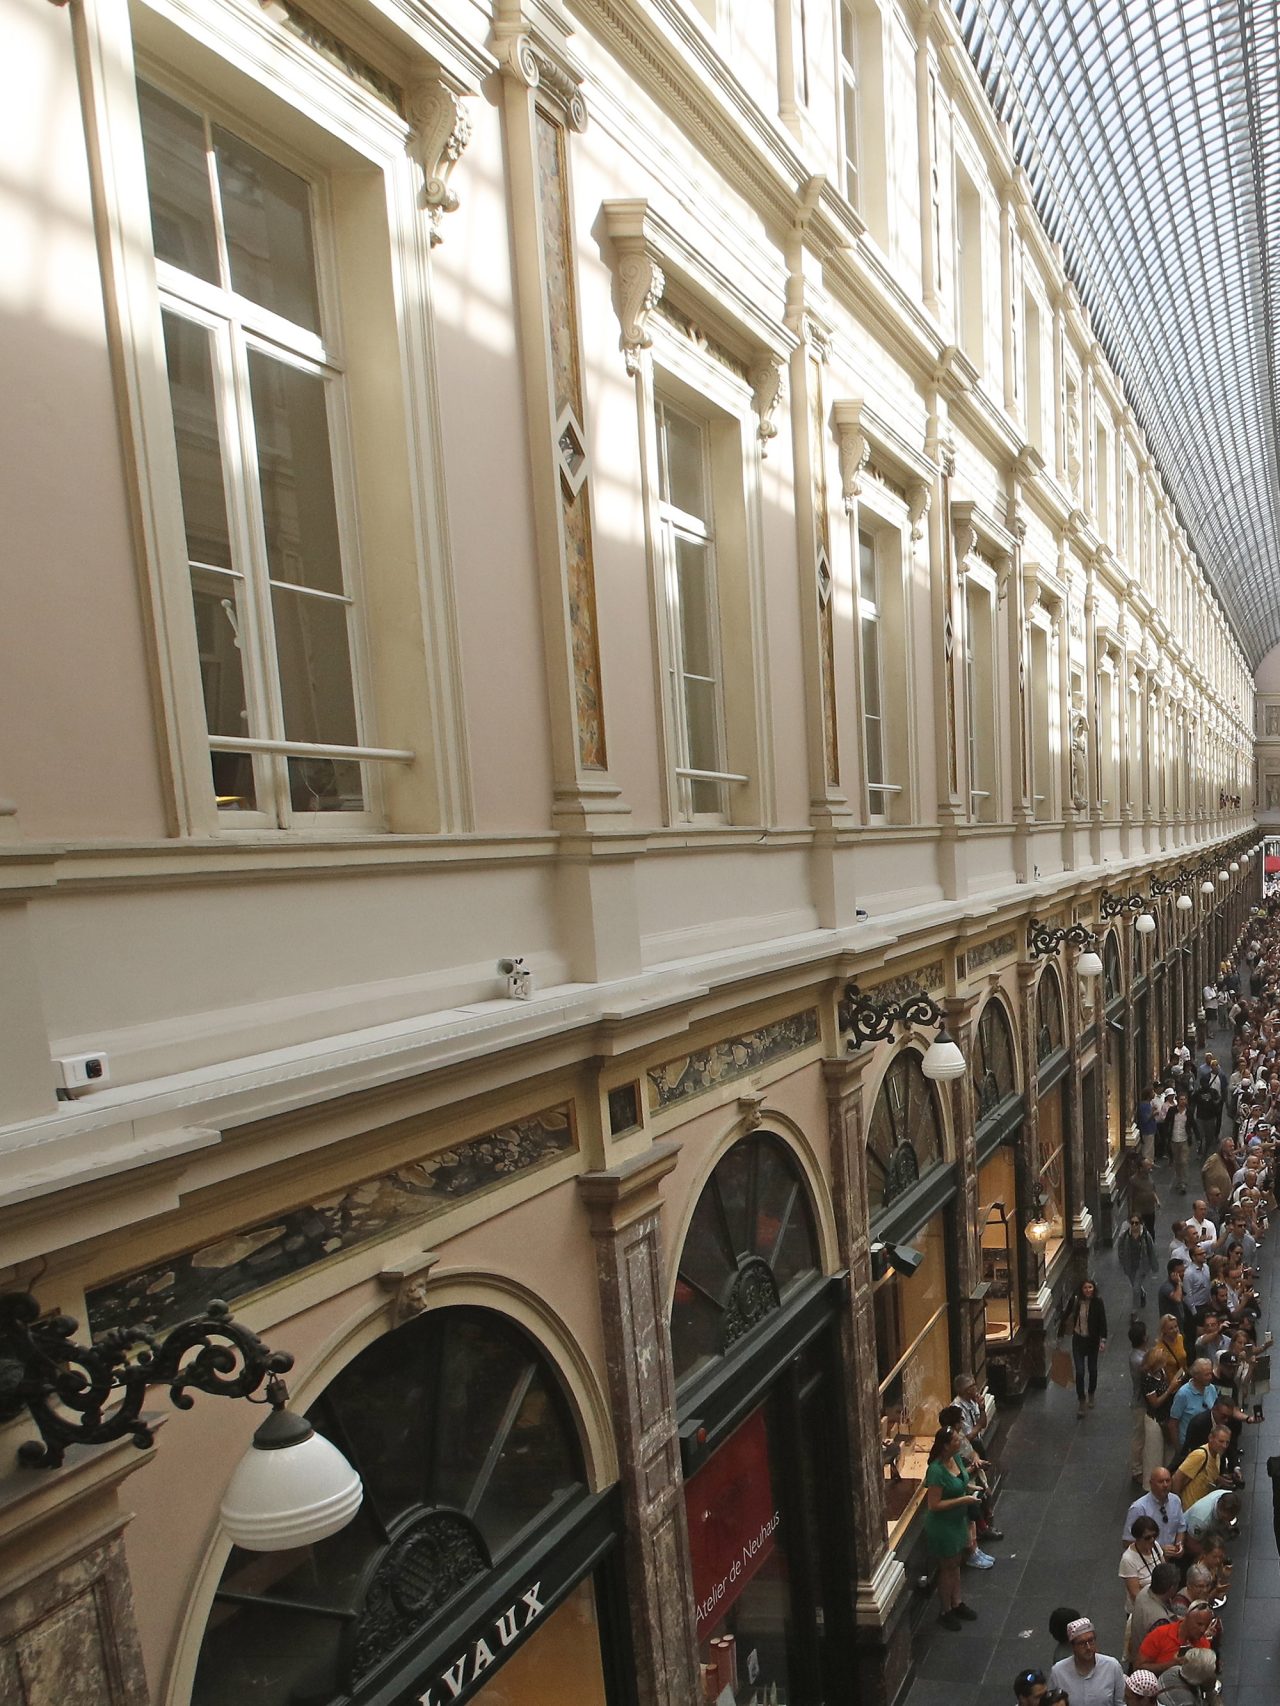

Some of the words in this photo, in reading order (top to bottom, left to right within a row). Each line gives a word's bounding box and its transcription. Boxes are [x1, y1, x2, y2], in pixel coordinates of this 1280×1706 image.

[695, 1577, 727, 1625] Atelier
[729, 1560, 741, 1582] de
[743, 1510, 780, 1566] Neuhaus
